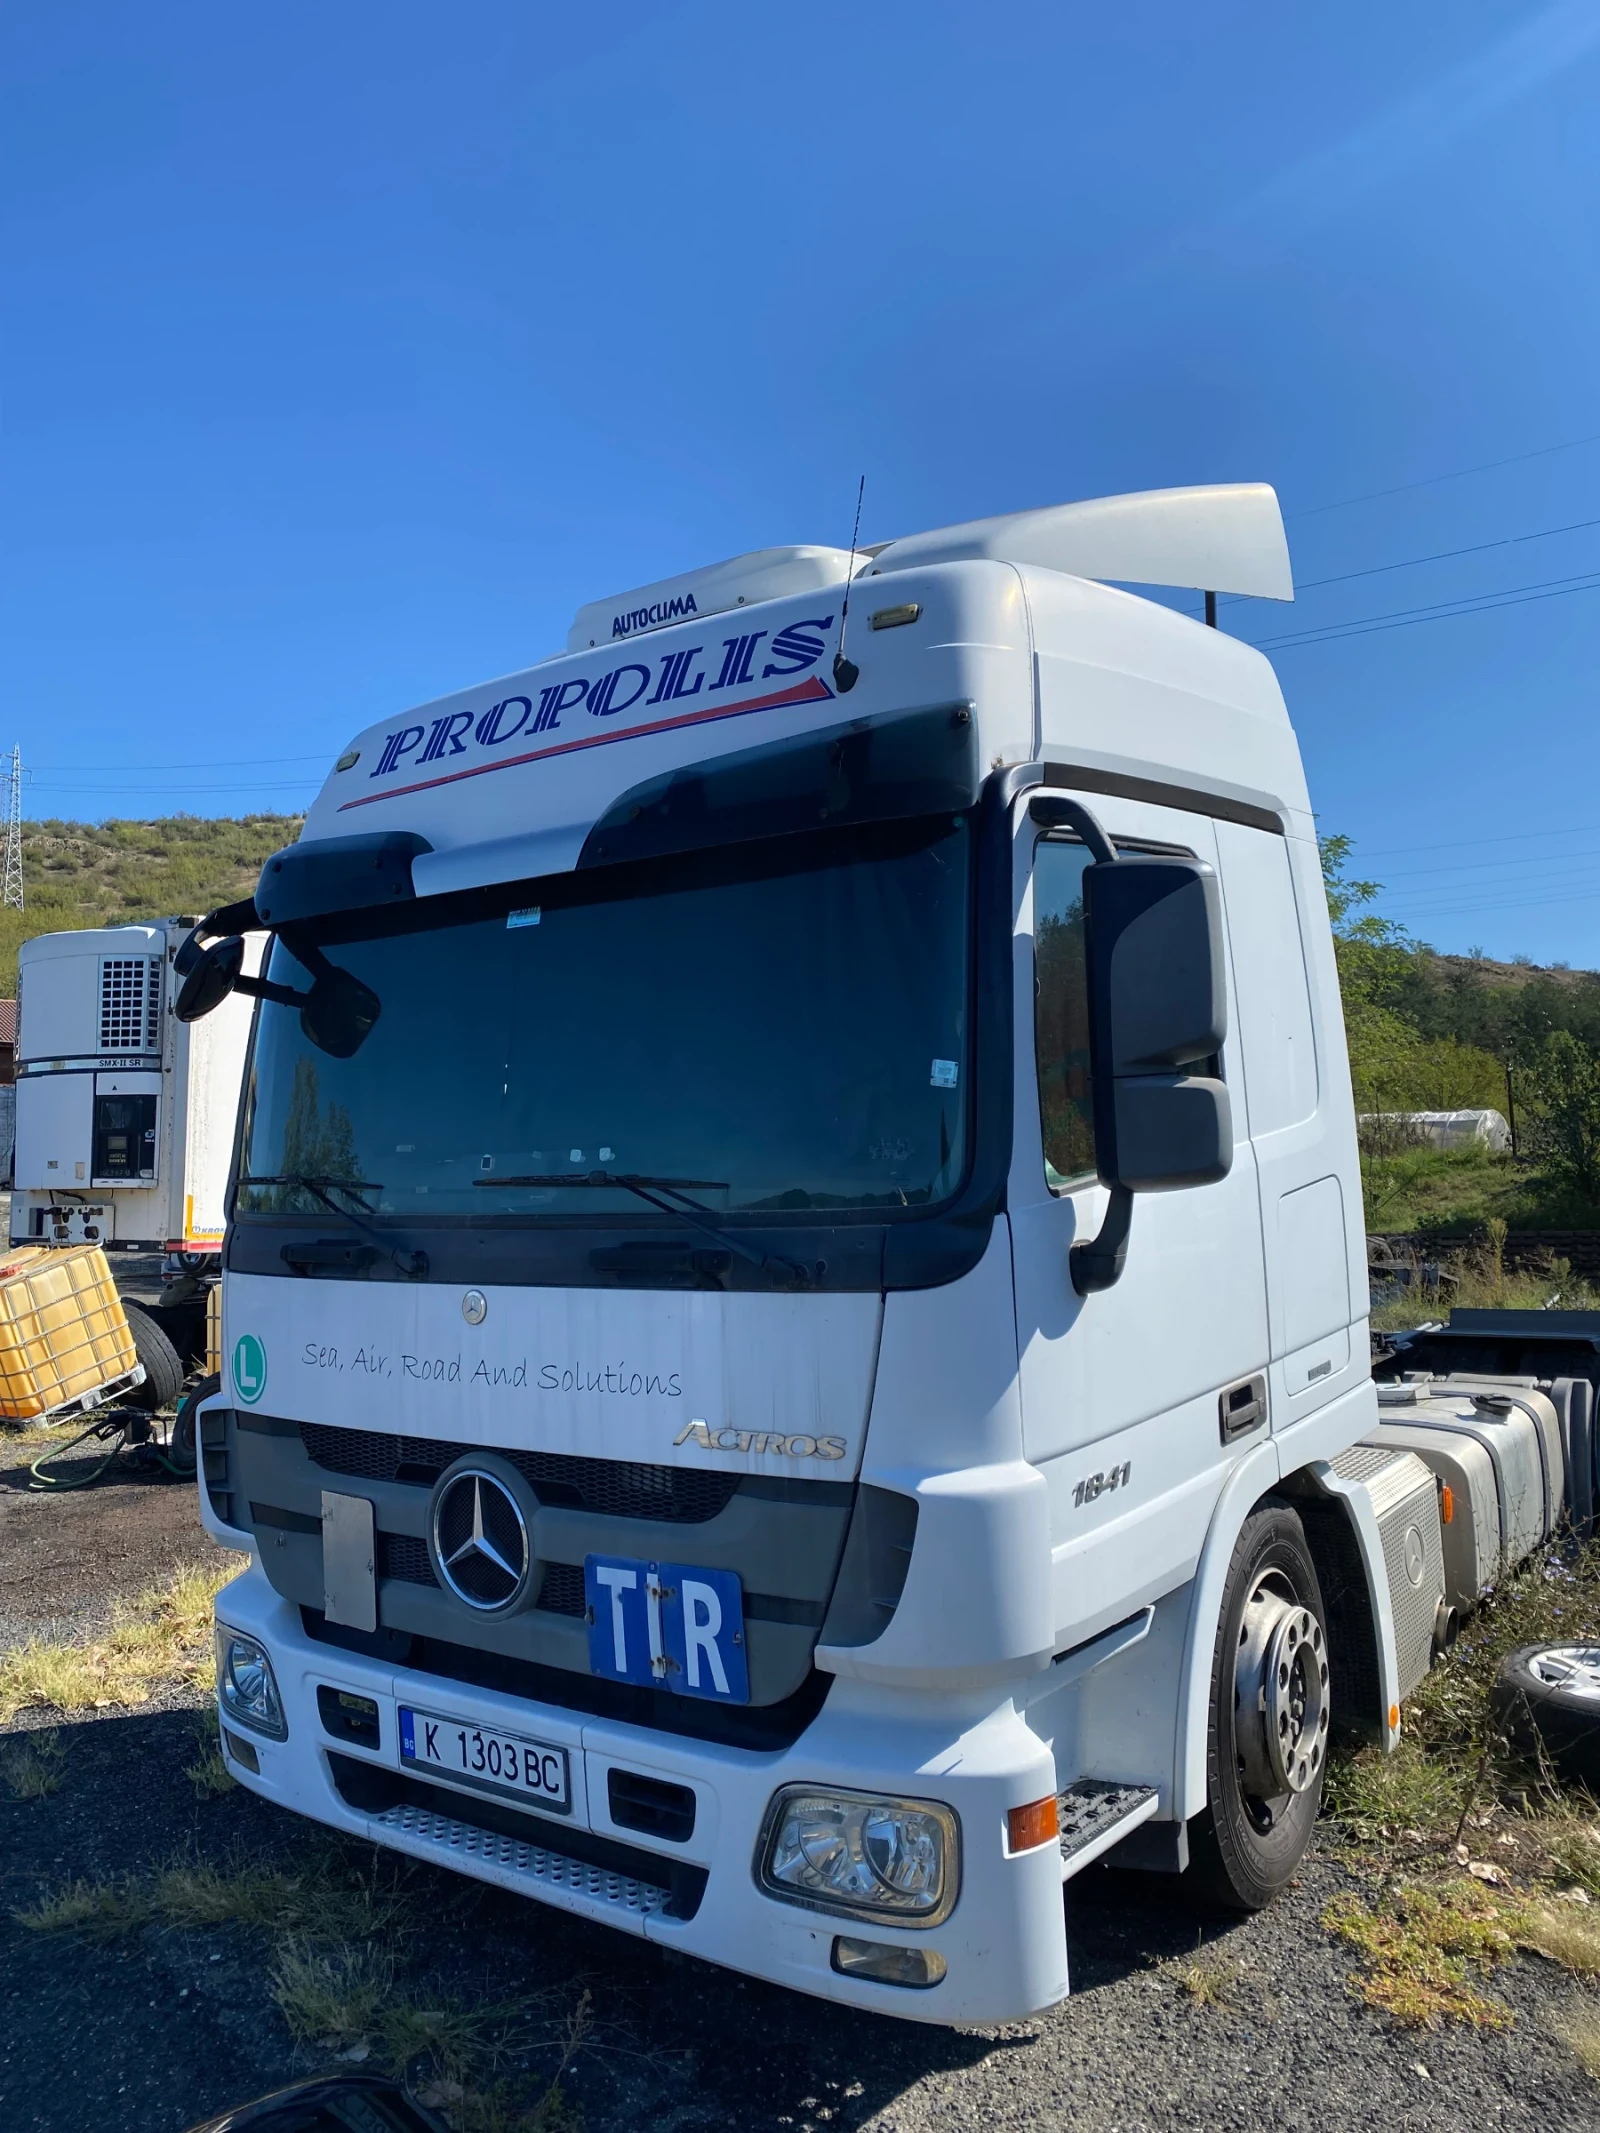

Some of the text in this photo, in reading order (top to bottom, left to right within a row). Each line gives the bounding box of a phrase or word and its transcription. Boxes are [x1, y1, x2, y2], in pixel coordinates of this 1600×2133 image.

[612, 593, 698, 638] AUTOCLIMA
[369, 615, 834, 778] PROPOLIS
[129, 1059, 141, 1067] SR
[301, 1343, 682, 1396] Sea, Air, Road And Solutions
[1071, 1460, 1132, 1509] 1841
[596, 1566, 731, 1694] TIR
[425, 1721, 441, 1761] K
